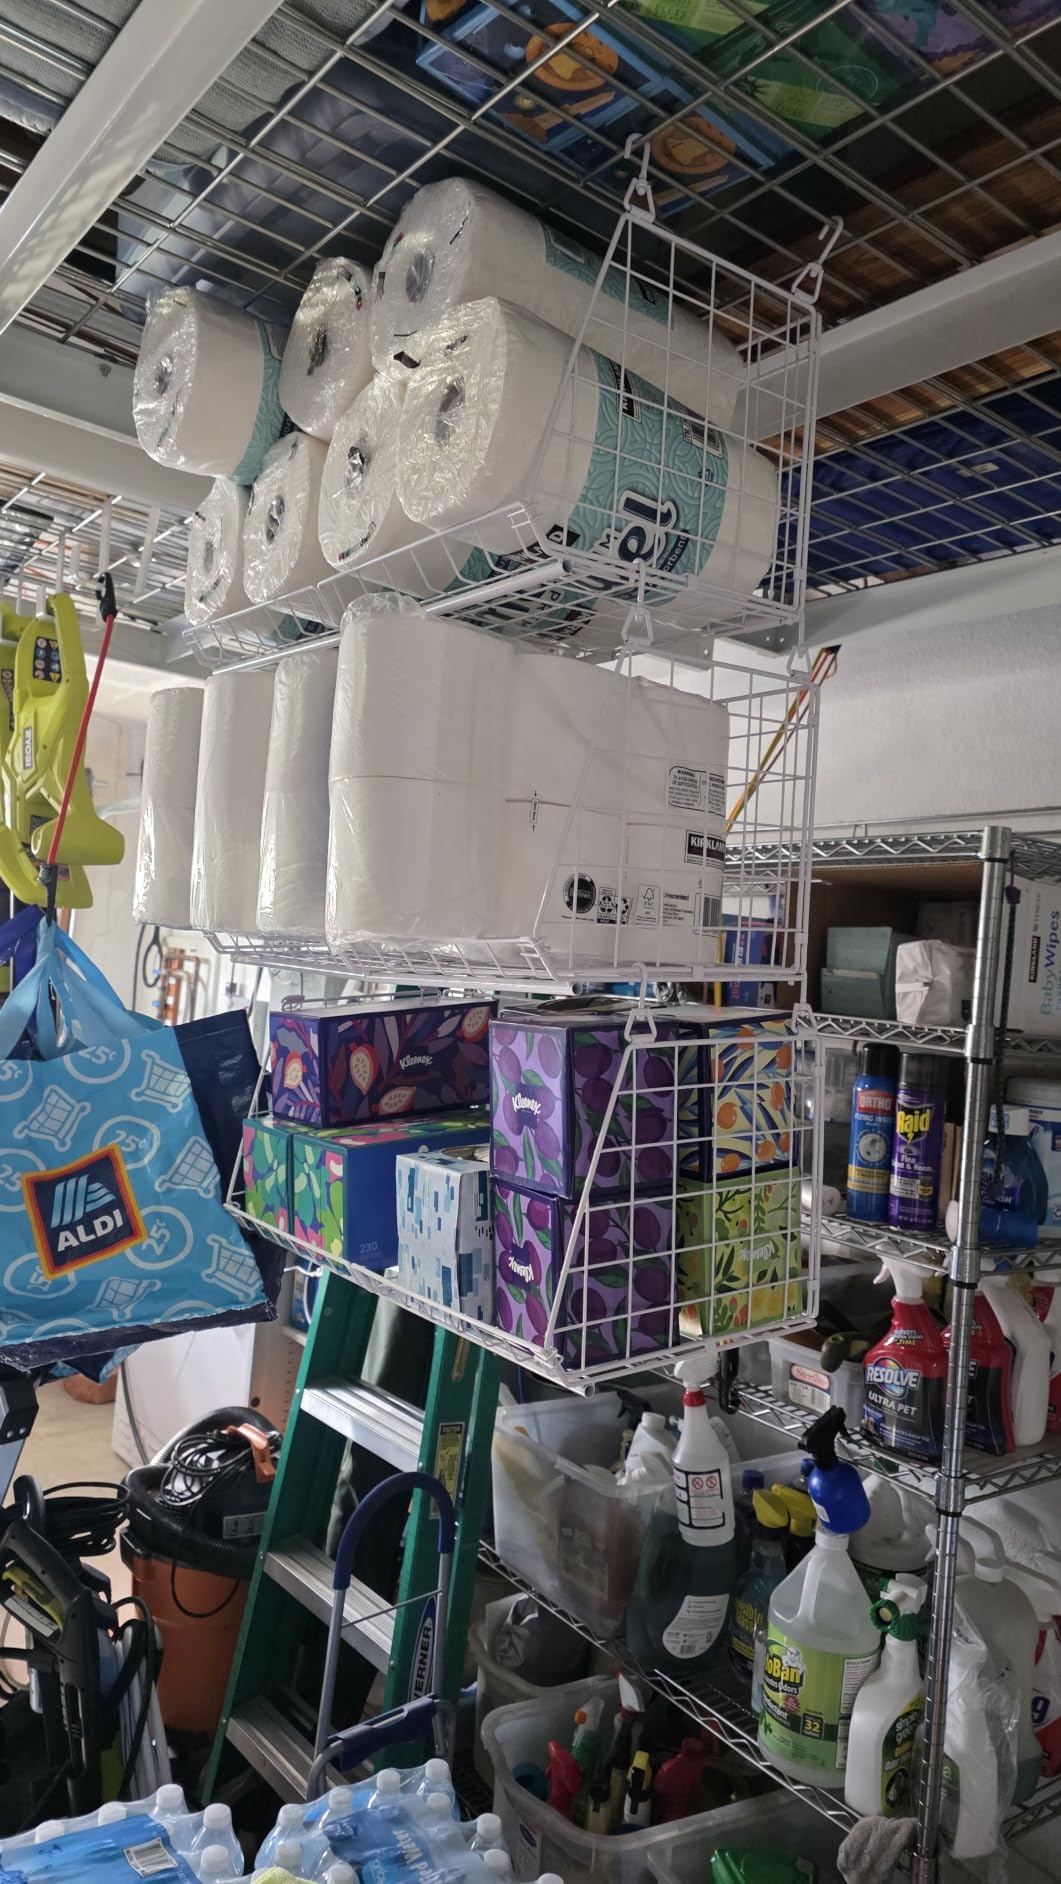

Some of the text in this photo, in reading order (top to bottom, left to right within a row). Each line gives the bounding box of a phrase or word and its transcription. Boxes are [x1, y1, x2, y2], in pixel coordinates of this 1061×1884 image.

[400, 1055, 433, 1070] Kleenex
[512, 1092, 541, 1115] Kleenex
[860, 1095, 892, 1110] ORTHO
[896, 1108, 931, 1133] Raid
[57, 1208, 123, 1252] ALDI
[359, 1241, 378, 1254] 230
[509, 1256, 534, 1283] Kleenex
[866, 1366, 919, 1388] RESOLVE
[868, 1390, 917, 1416] ULTRA PET
[804, 1720, 821, 1733] 32
